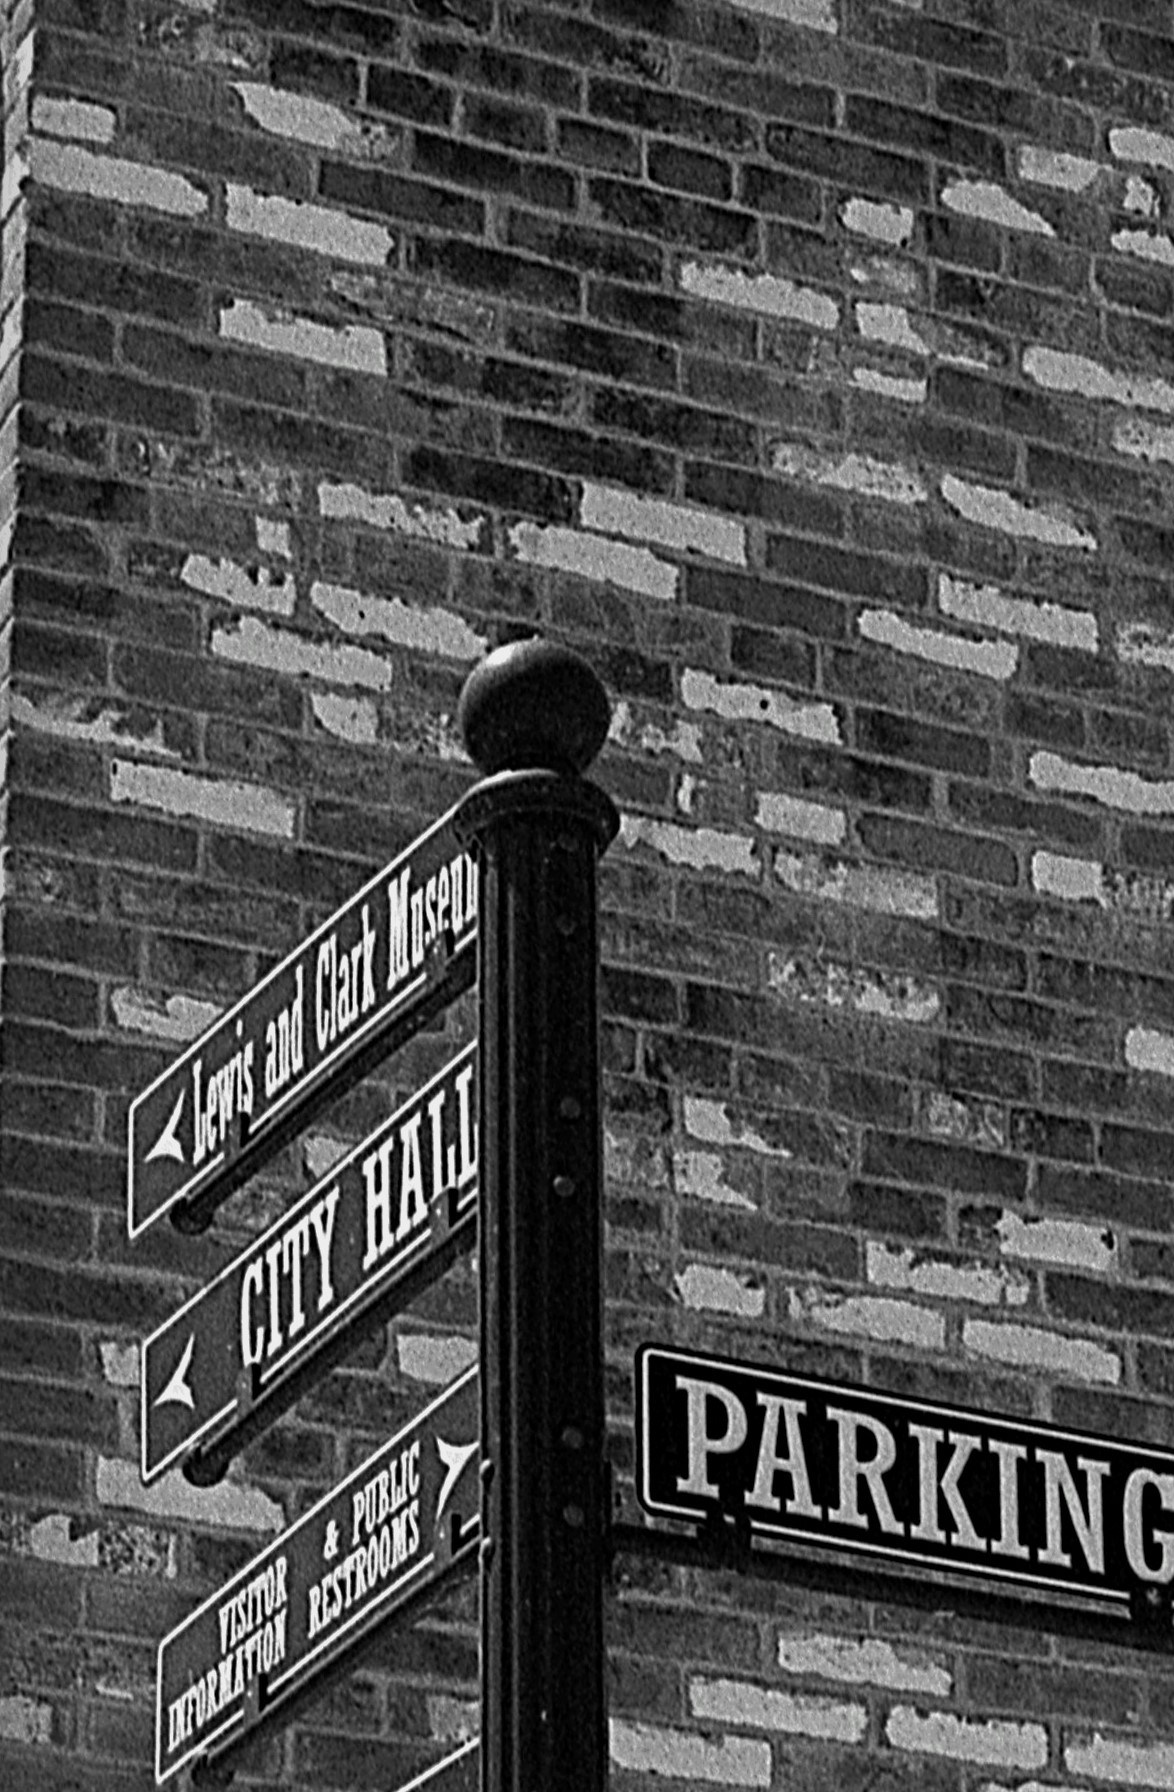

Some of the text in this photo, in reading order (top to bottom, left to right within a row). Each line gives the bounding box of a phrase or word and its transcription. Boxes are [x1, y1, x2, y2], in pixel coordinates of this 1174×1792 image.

[192, 1018, 255, 1166] Lewis
[264, 964, 304, 1099] and
[314, 904, 377, 1052] Clark
[241, 1063, 480, 1368] CITY HALL
[308, 1500, 420, 1639] RESTROOMS
[323, 1440, 421, 1560] & PUBLIC
[218, 1556, 289, 1654] VISITOR
[167, 1608, 288, 1753] INFORMATION
